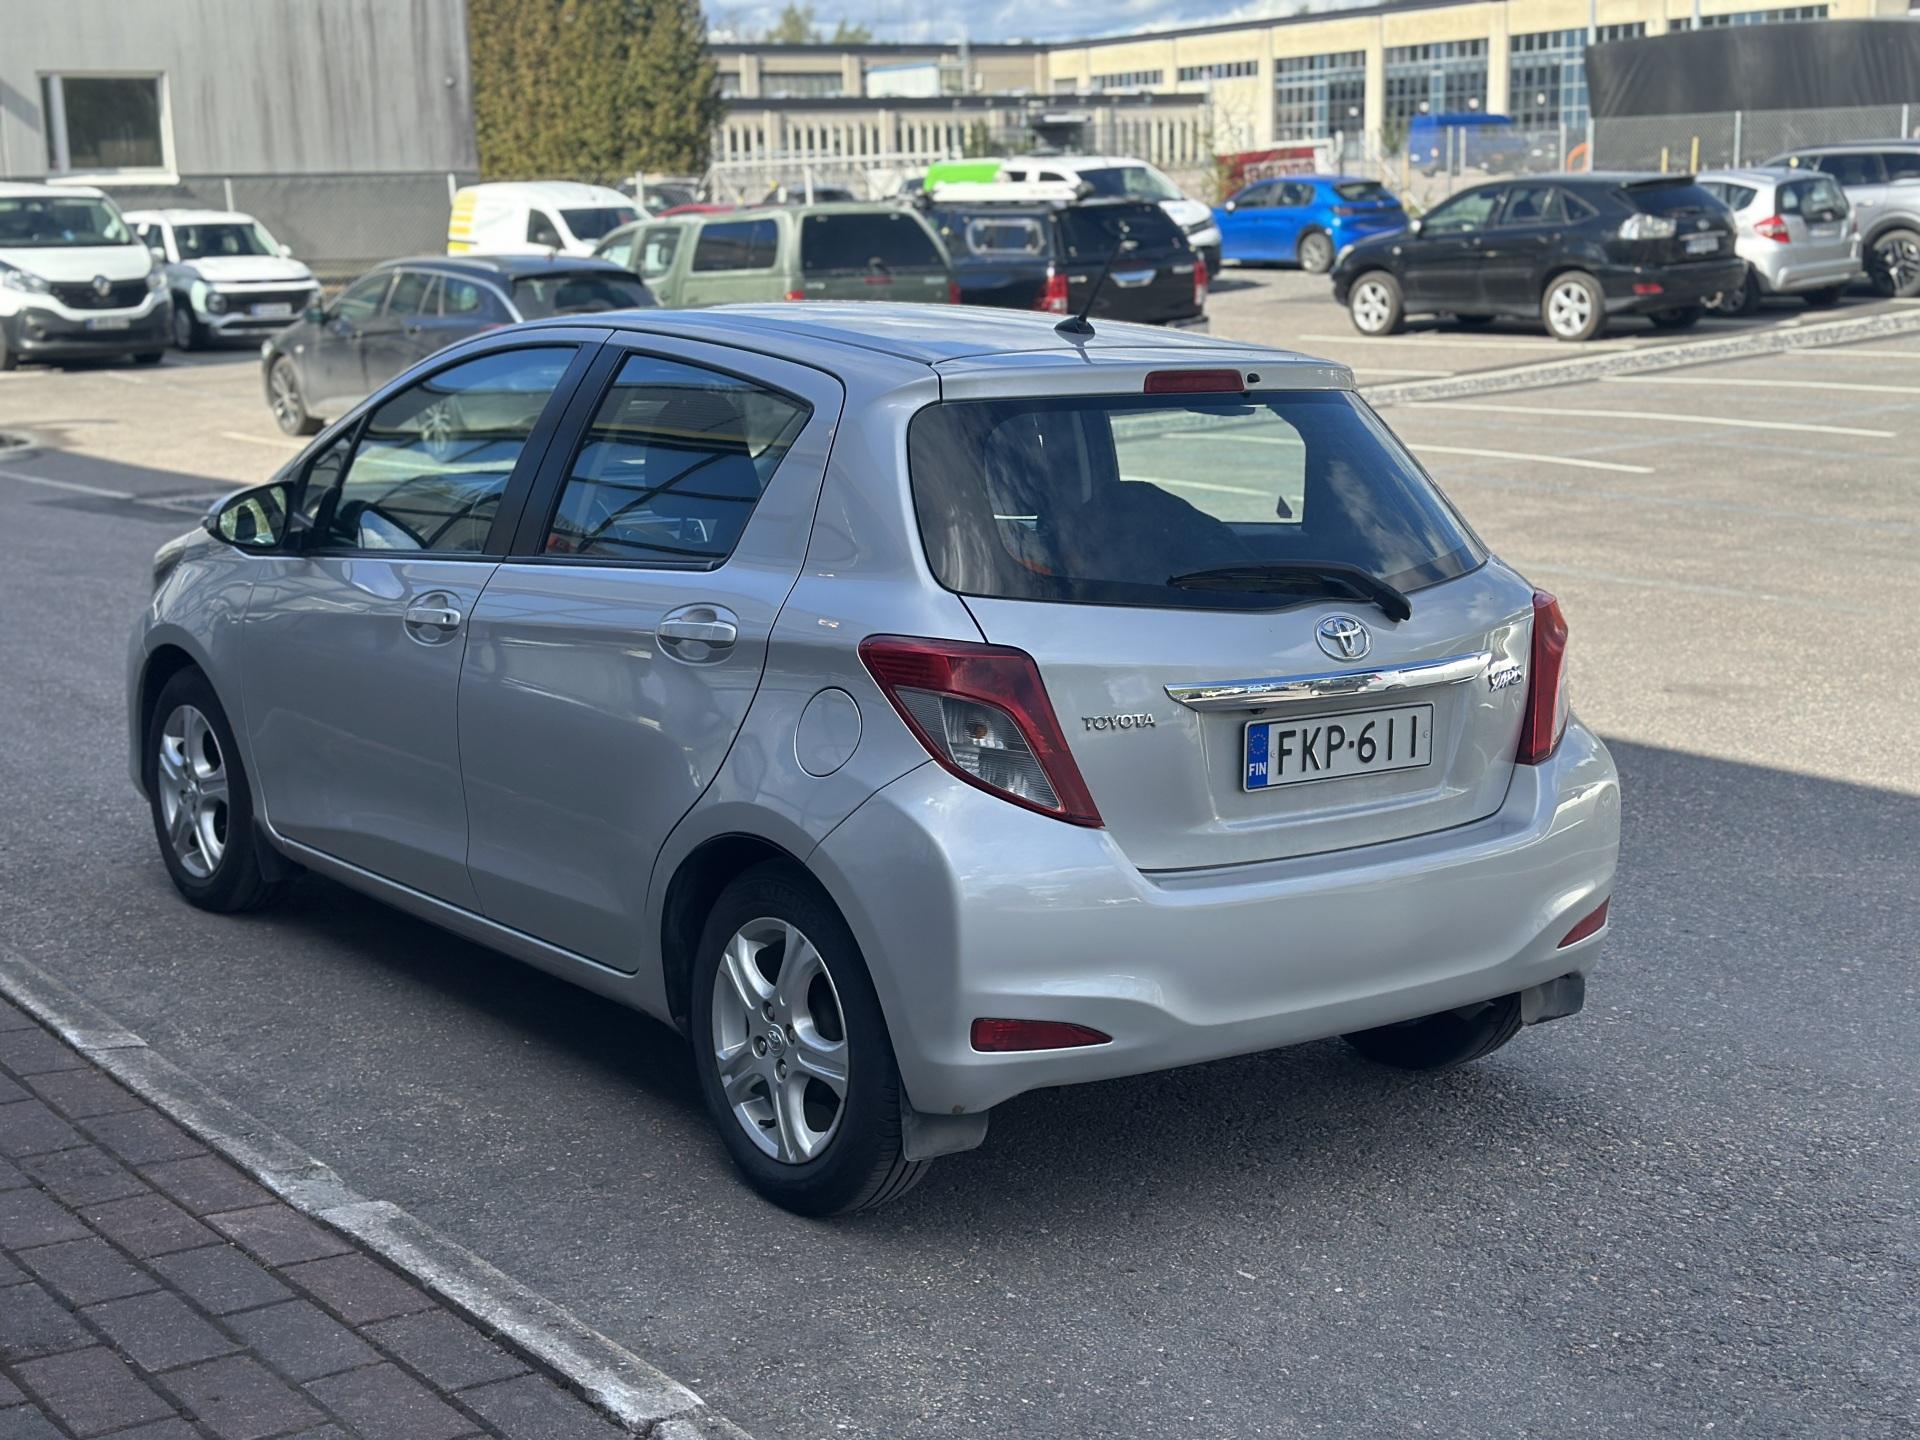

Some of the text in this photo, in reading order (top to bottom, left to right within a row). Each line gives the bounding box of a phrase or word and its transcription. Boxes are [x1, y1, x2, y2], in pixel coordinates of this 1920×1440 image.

[1081, 713, 1156, 731] TOYOTA
[1277, 715, 1417, 775] FKP-611
[1249, 761, 1267, 777] FIN
